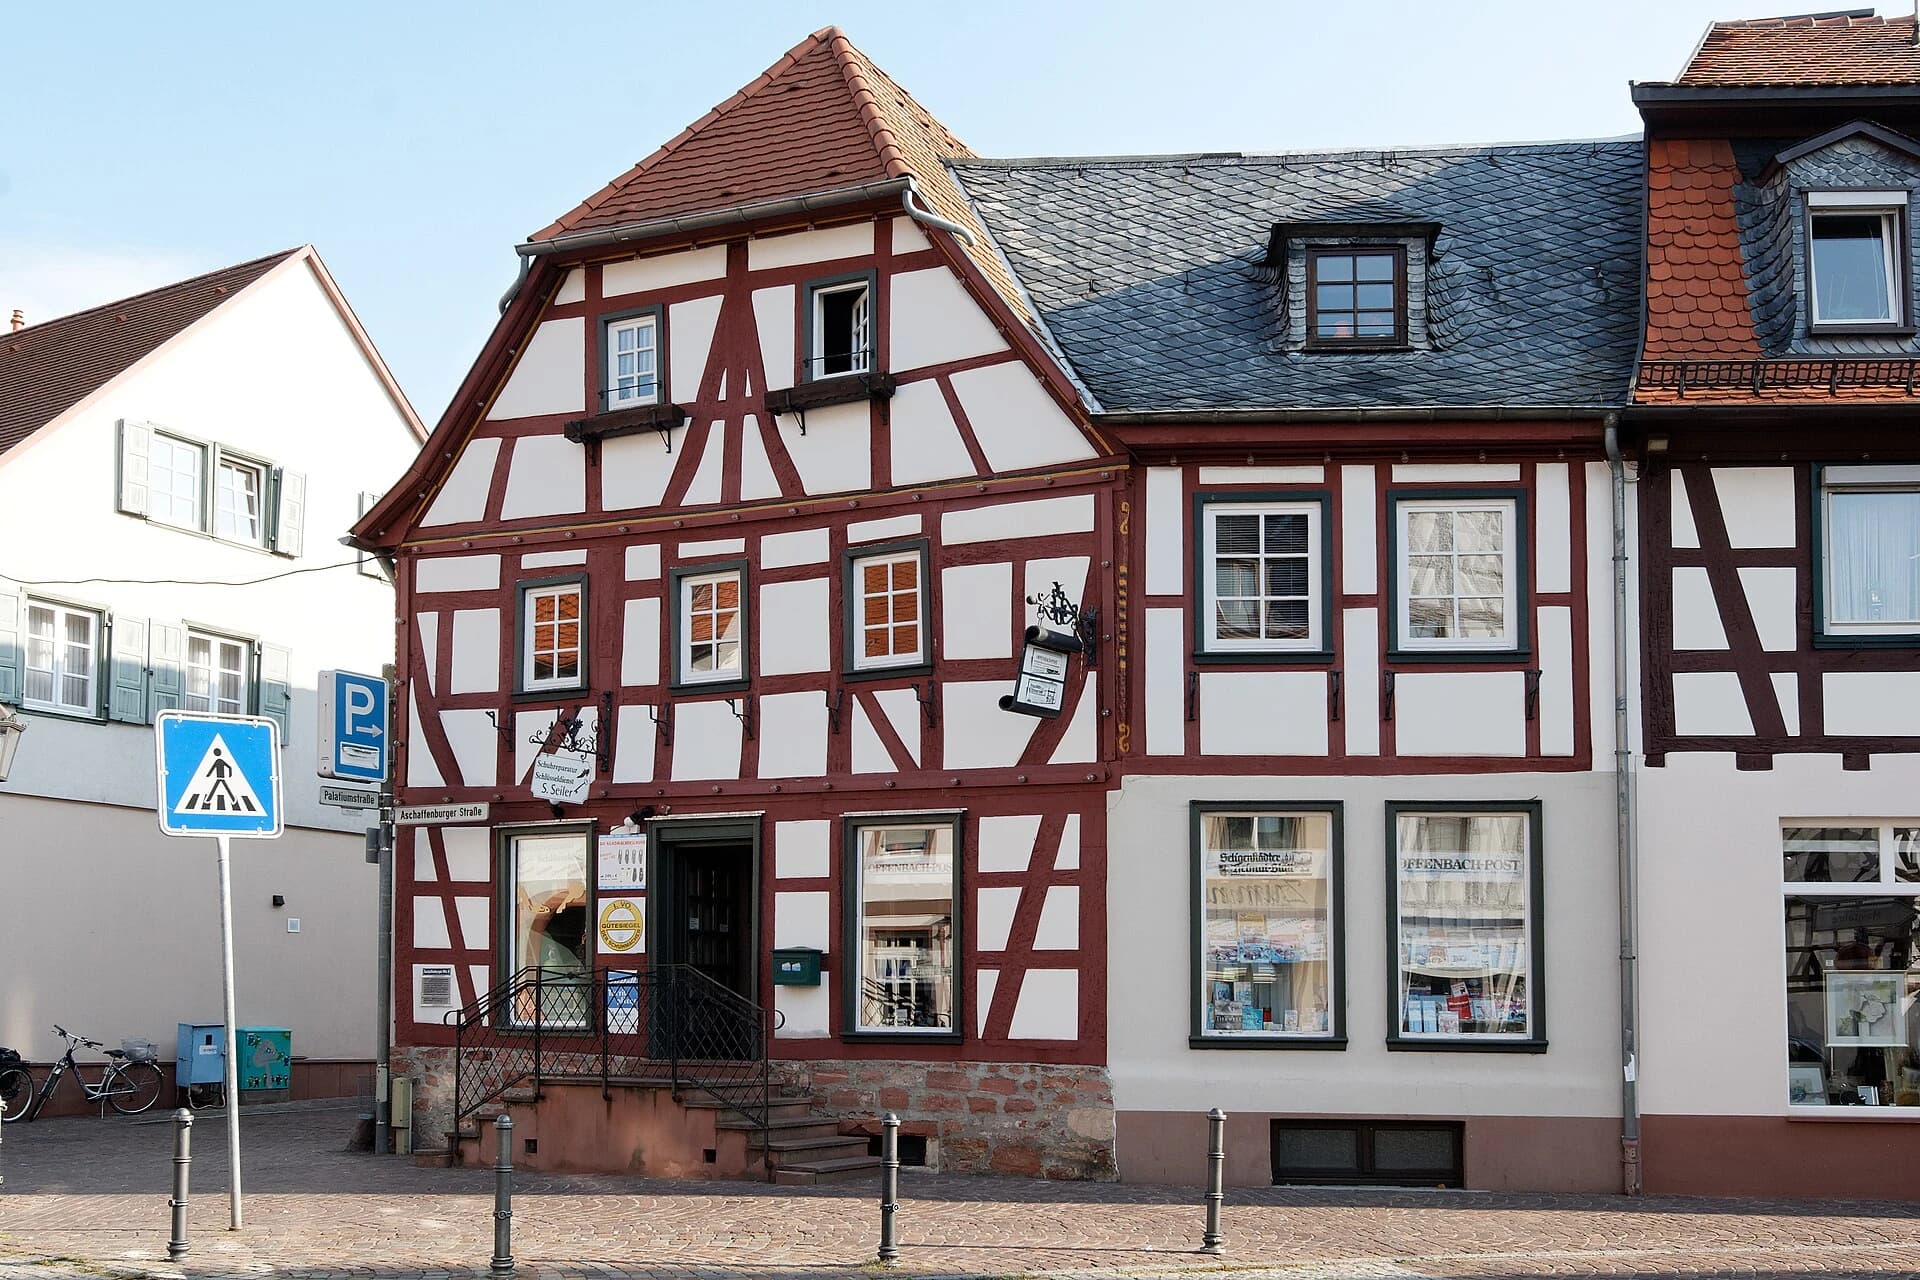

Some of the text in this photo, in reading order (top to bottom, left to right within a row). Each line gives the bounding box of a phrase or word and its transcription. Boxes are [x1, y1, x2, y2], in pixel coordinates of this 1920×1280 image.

[345, 682, 375, 736] P
[541, 783, 573, 797] S. Seiler
[324, 790, 375, 805] Palatiumstraße
[400, 807, 482, 820] Aschaffenburger Straße
